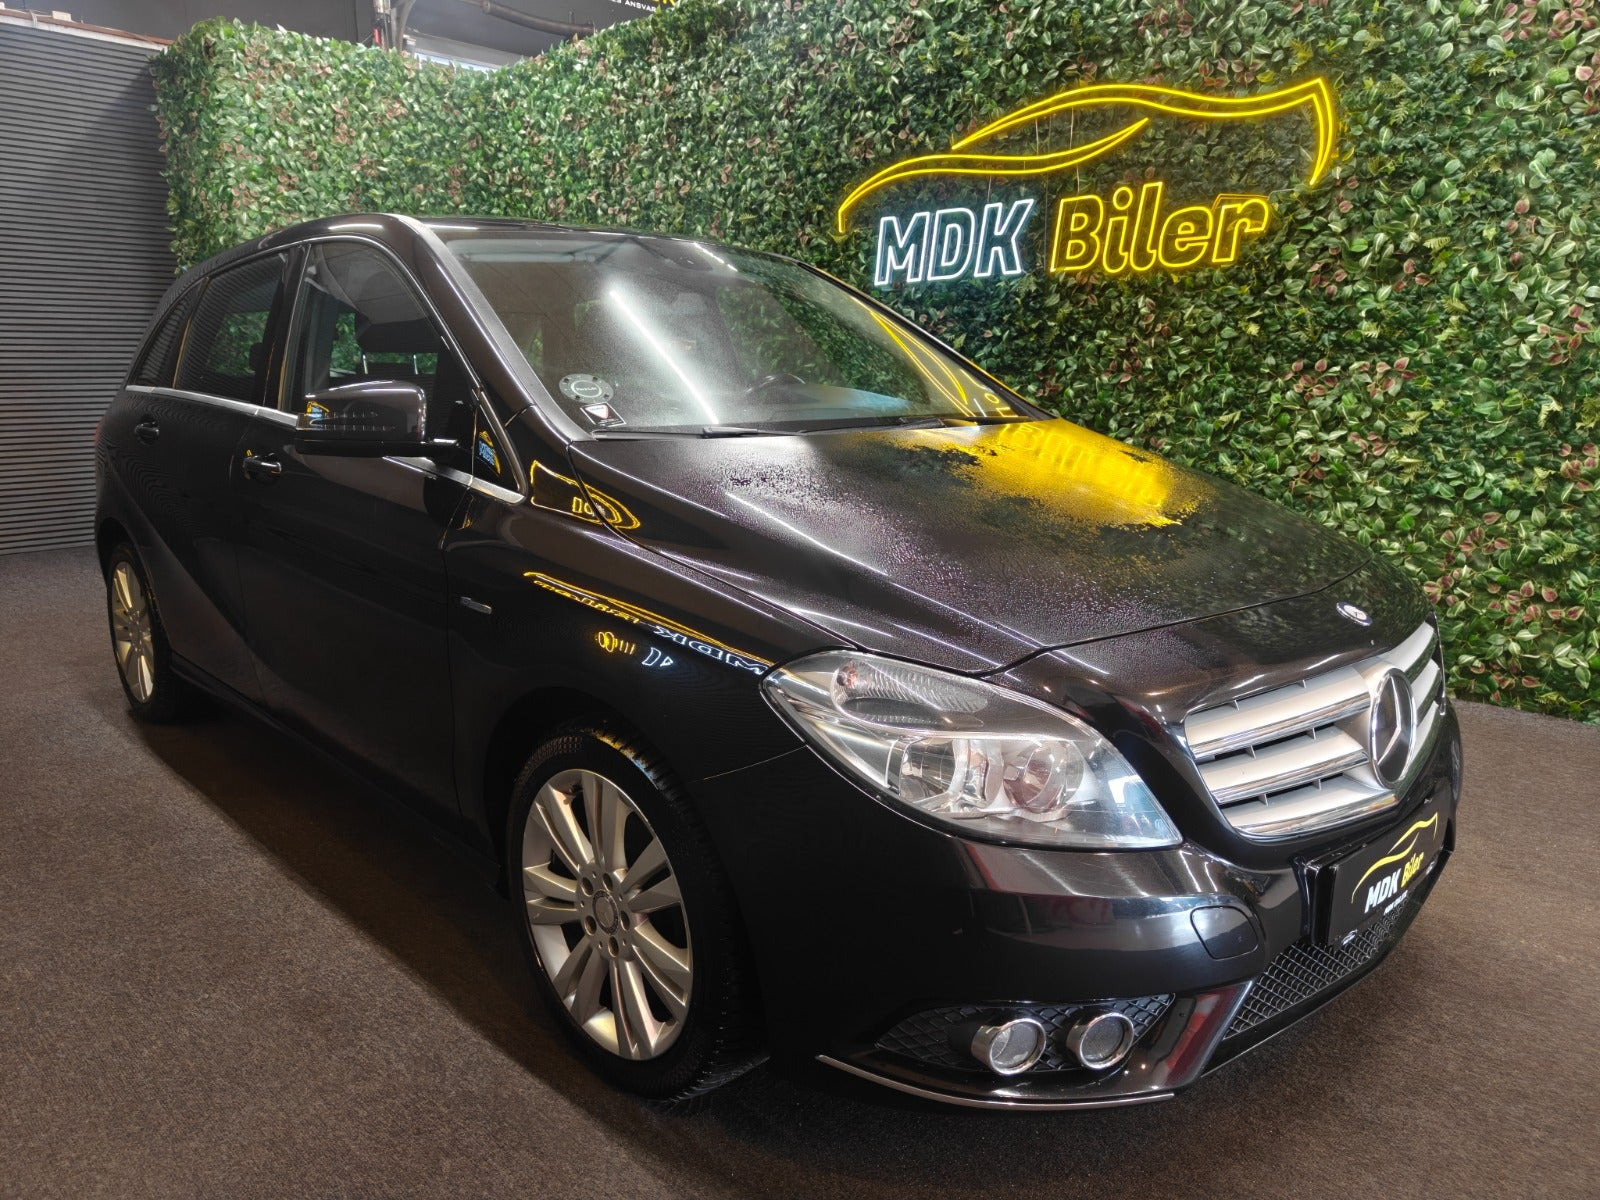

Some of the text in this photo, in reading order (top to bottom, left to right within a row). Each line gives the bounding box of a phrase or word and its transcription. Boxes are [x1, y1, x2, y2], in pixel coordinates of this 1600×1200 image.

[875, 181, 1269, 287] MDK Biler
[1364, 868, 1401, 914] MDK
[1401, 852, 1424, 888] Biler
